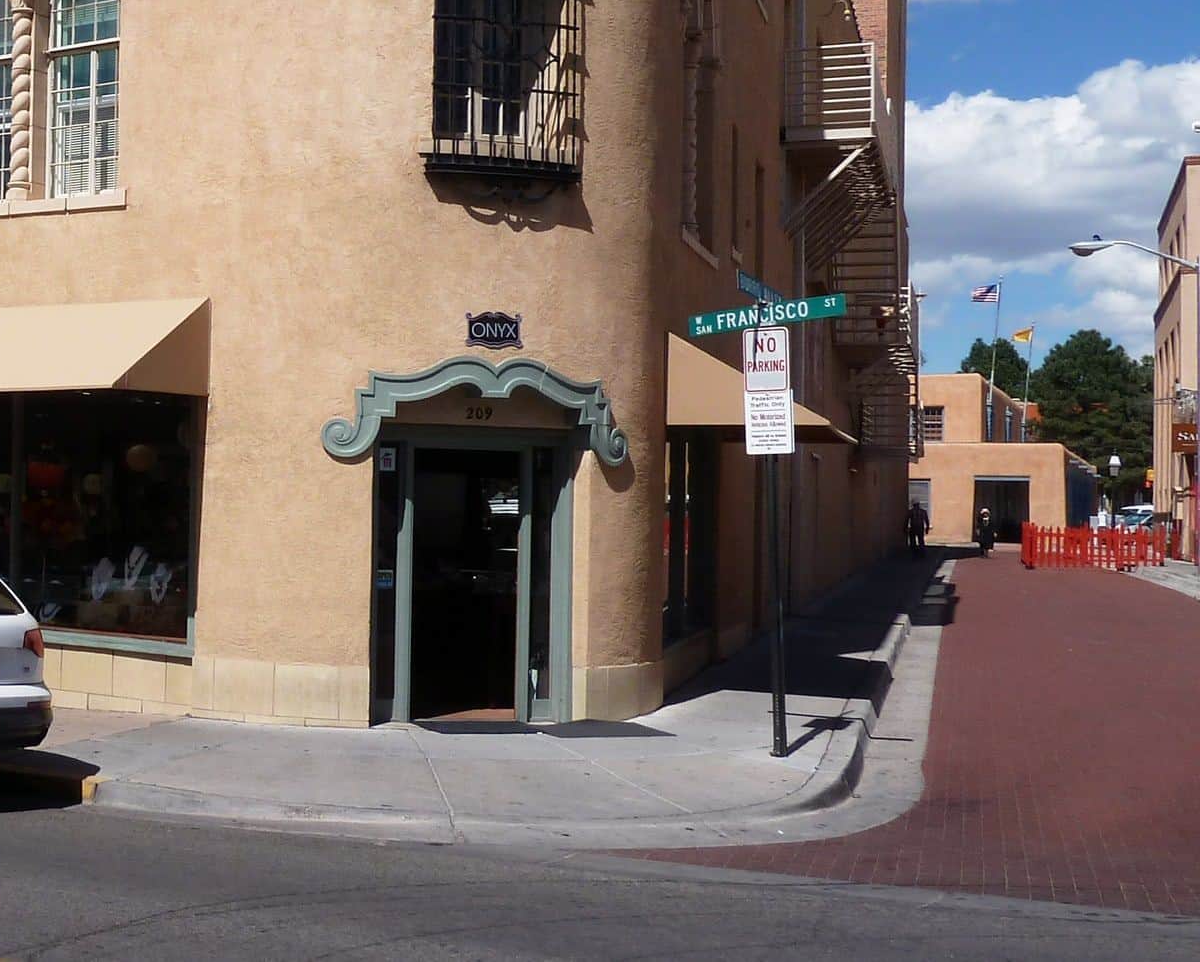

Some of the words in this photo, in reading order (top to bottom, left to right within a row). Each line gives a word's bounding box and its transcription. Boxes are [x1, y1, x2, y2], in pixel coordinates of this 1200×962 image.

[695, 325, 713, 335] SAN
[716, 301, 809, 330] FRANCISCO
[824, 297, 837, 308] ST
[471, 322, 517, 338] ONYX
[754, 337, 777, 353] NO
[747, 359, 785, 373] PARKING
[465, 406, 493, 420] 209
